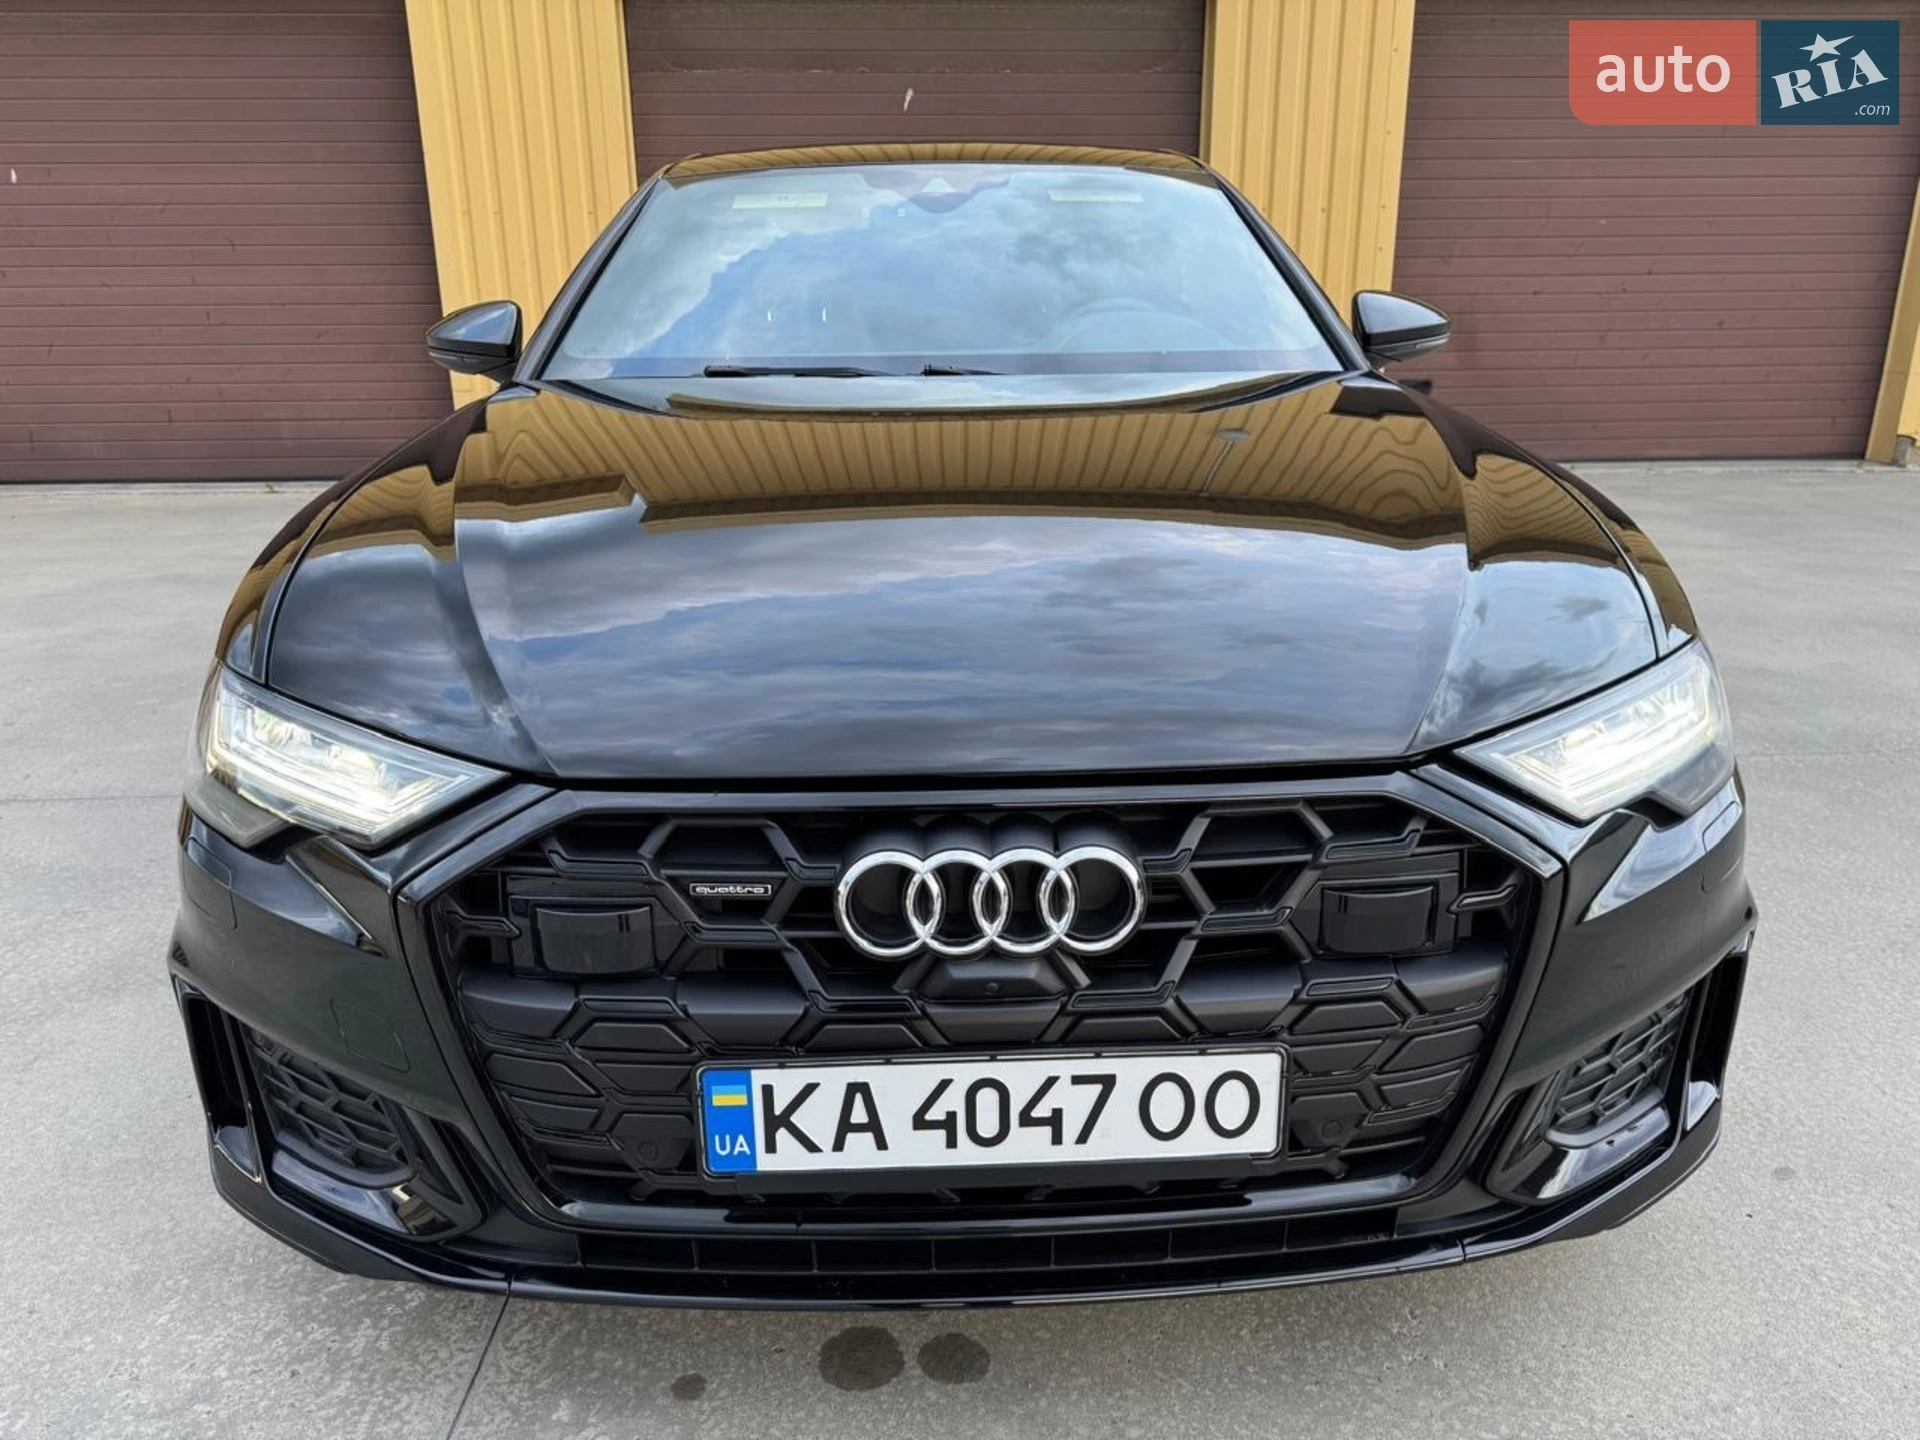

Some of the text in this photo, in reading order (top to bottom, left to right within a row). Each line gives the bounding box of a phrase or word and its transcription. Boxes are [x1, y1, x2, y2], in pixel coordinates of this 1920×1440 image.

[695, 885, 765, 895] quattro
[759, 1070, 1261, 1154] KA 4047 OO
[714, 1134, 751, 1156] UA
